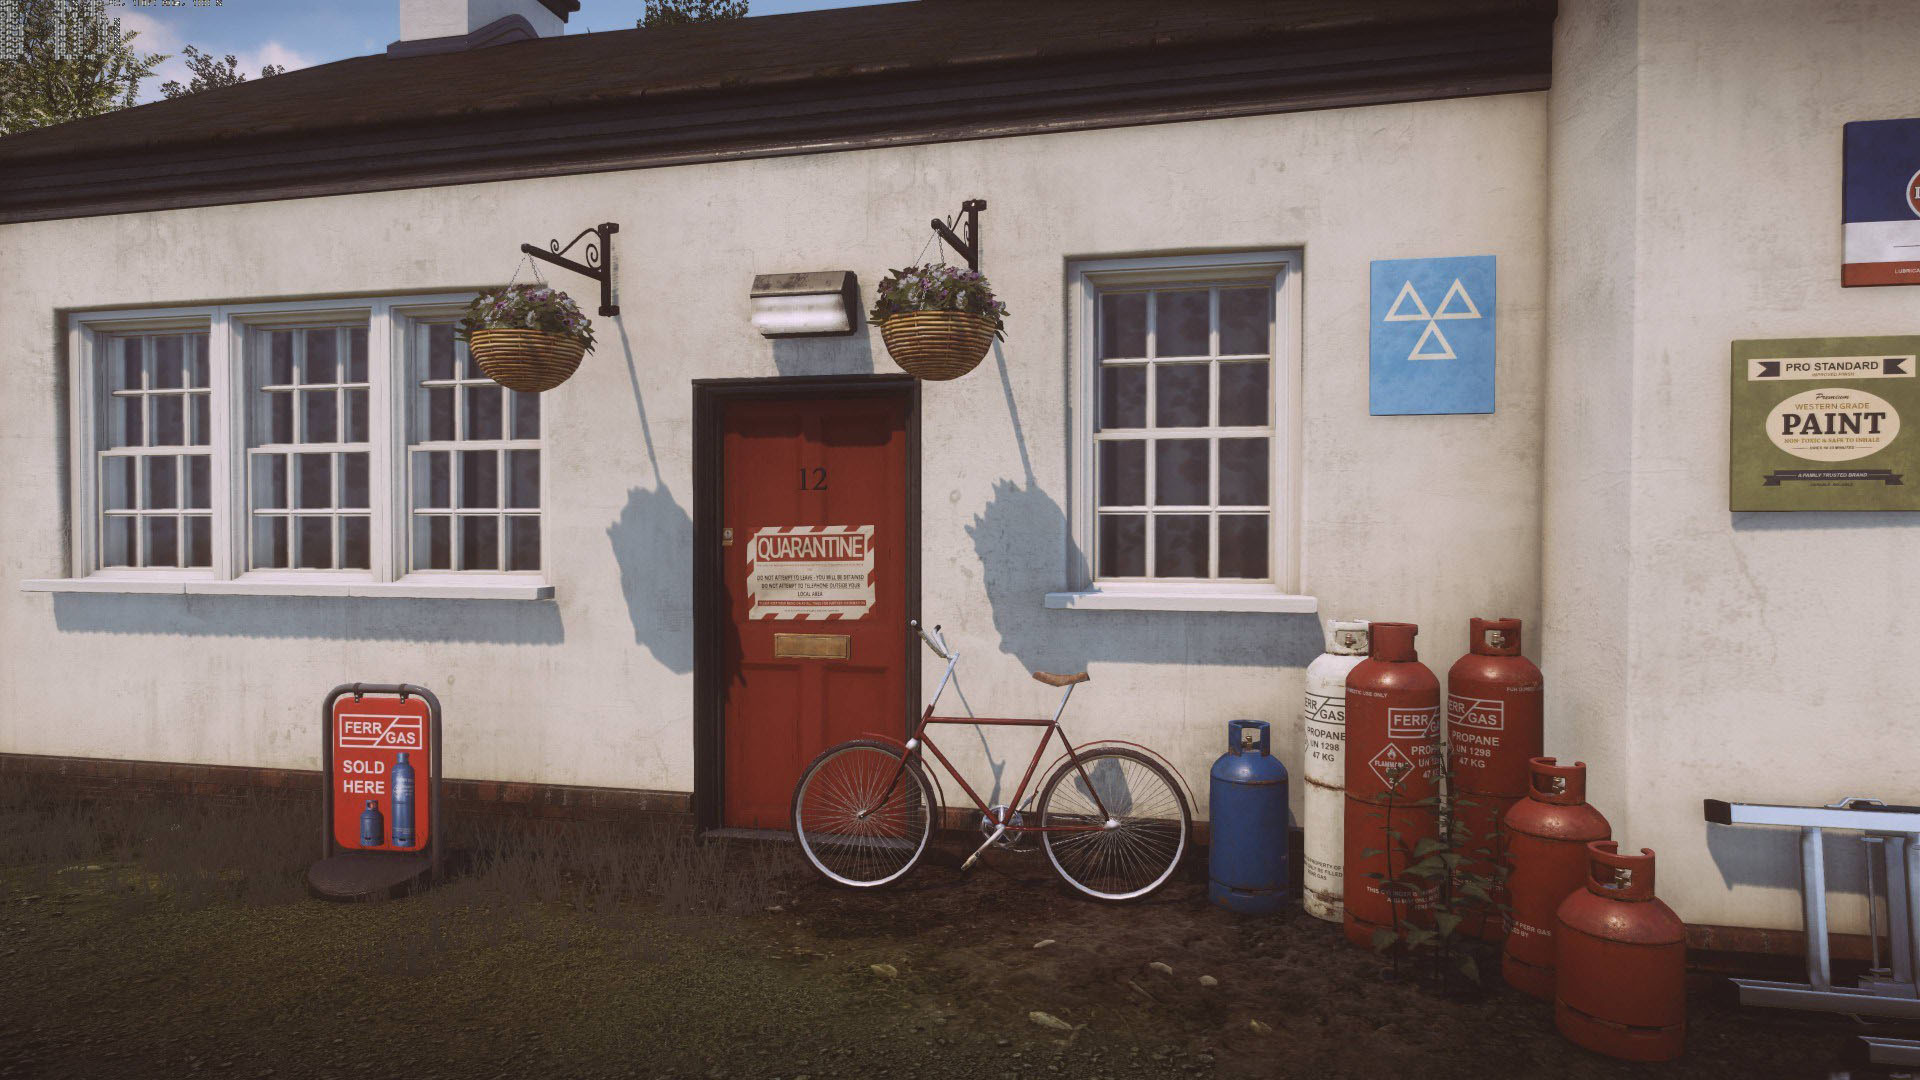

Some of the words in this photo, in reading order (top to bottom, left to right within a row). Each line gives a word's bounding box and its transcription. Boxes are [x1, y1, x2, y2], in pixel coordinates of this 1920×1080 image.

[1786, 363, 1811, 372] PRO
[1814, 361, 1879, 371] STANDARD
[1839, 402, 1870, 410] GRADE
[1781, 412, 1886, 436] PAINT
[800, 467, 828, 491] 12
[758, 536, 864, 561] QUARANTINE
[1305, 697, 1317, 710] ERR
[1320, 709, 1345, 722] GAS
[1448, 701, 1465, 713] ERR
[1468, 712, 1497, 726] GAS
[1393, 714, 1429, 726] FERR
[345, 721, 383, 735] FERR
[386, 731, 416, 744] GAS
[1307, 726, 1346, 741] PROPANE
[1452, 730, 1500, 747] PROPANE
[1321, 742, 1339, 752] 1298
[1456, 745, 1467, 753] UN
[1469, 747, 1491, 757] 1298
[1313, 751, 1320, 759] 47
[1322, 753, 1335, 762] KG
[1459, 756, 1468, 765] 47
[1470, 759, 1486, 768] KG
[343, 760, 385, 774] SOLD
[343, 780, 385, 795] HERE
[1367, 886, 1379, 895] THIS
[1537, 928, 1551, 937] GAS
